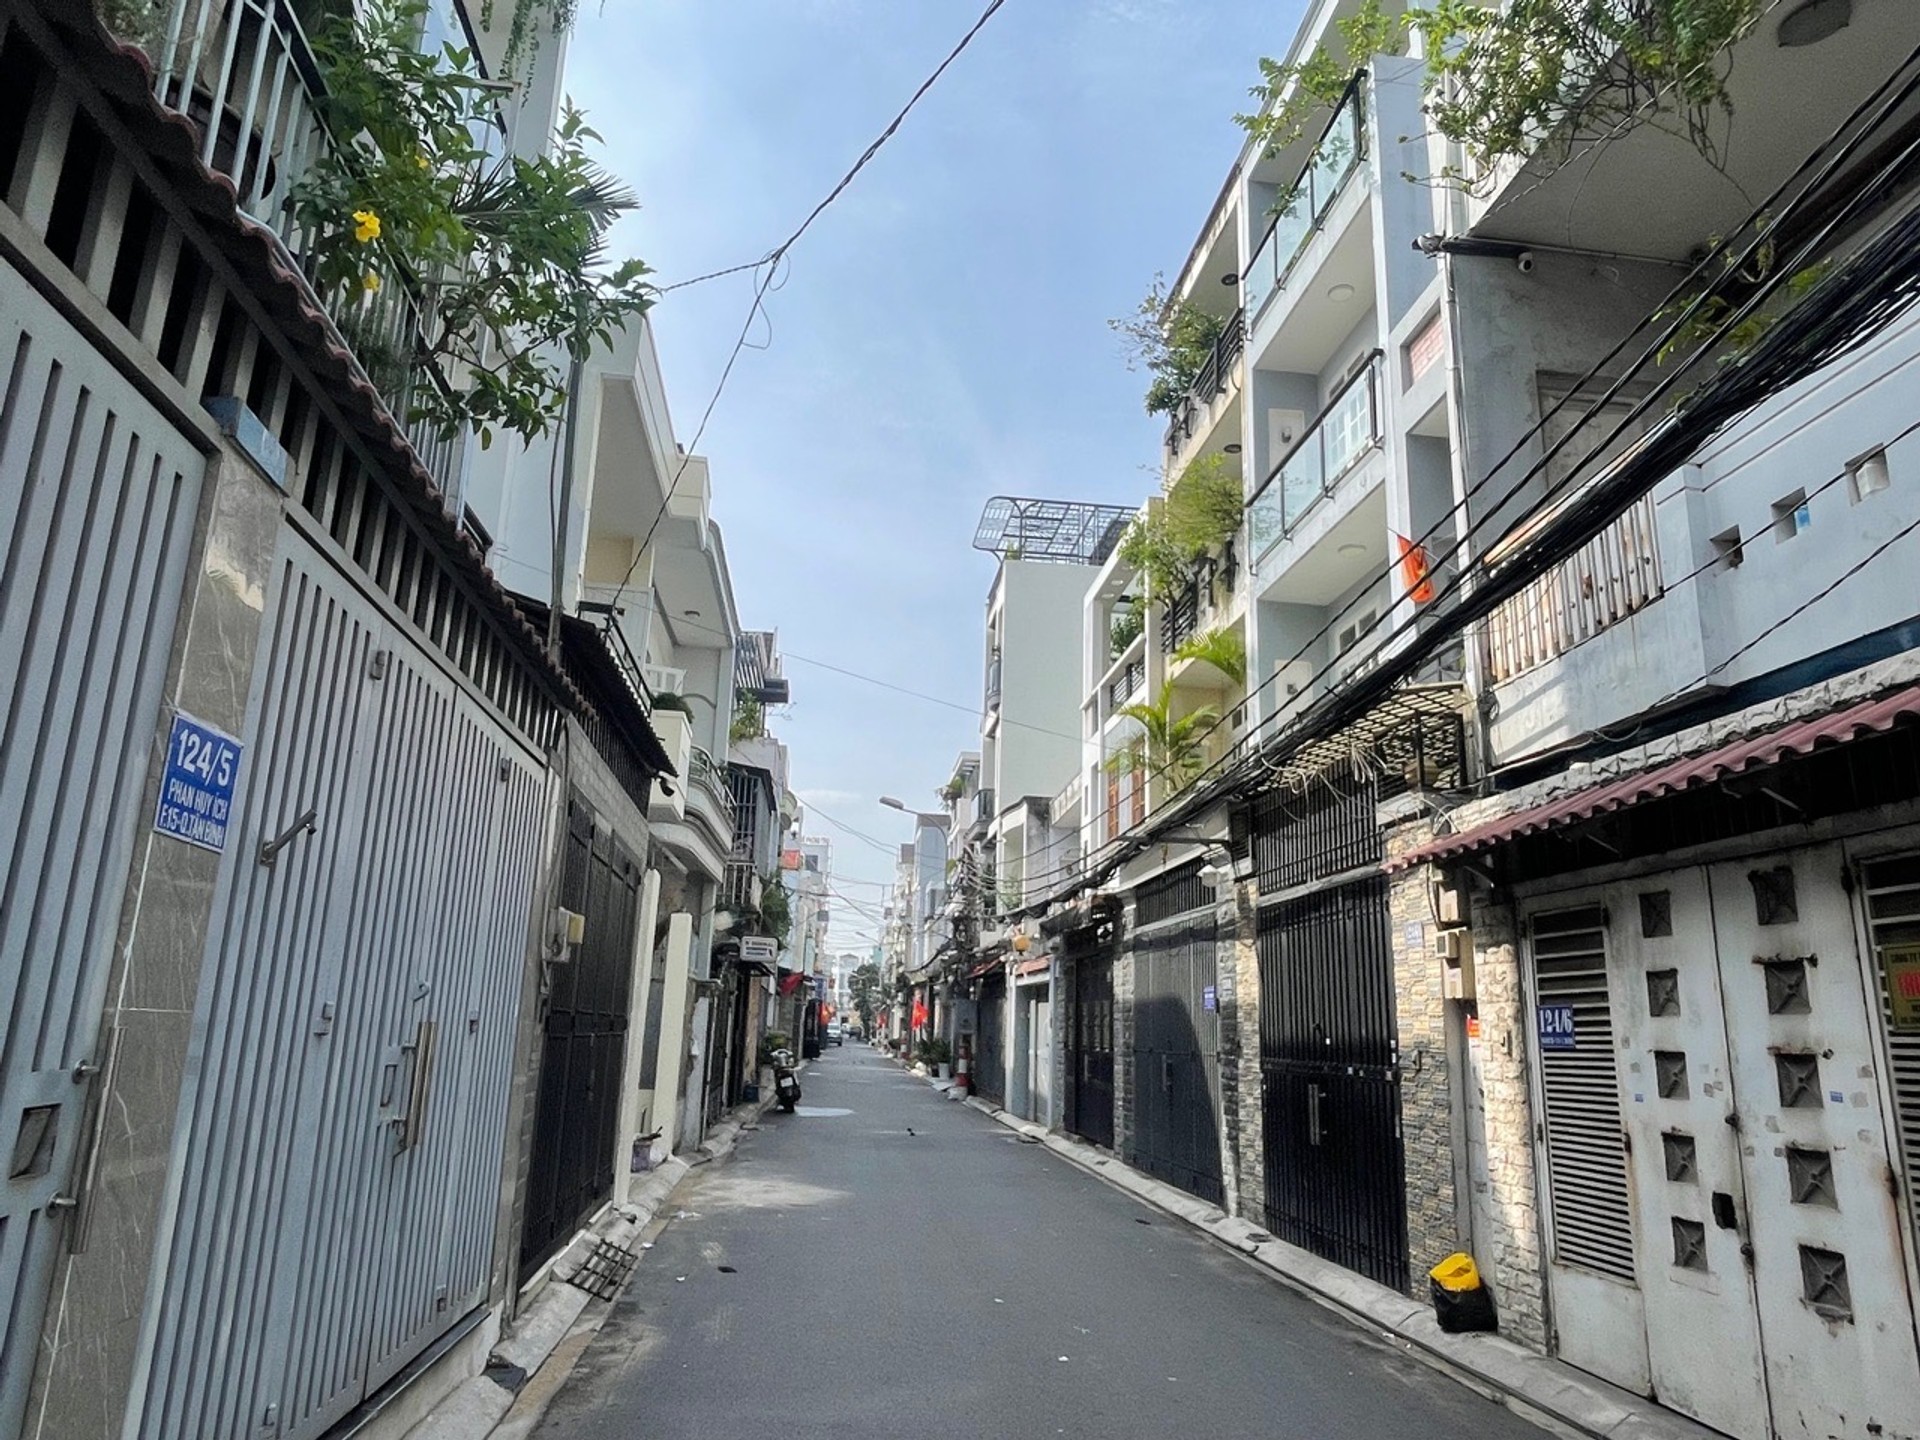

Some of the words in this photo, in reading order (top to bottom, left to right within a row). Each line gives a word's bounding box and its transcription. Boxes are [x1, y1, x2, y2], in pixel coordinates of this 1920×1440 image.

[177, 729, 233, 787] 124/5
[167, 777, 197, 808] PHAN
[1540, 1008, 1572, 1033] 124/6
